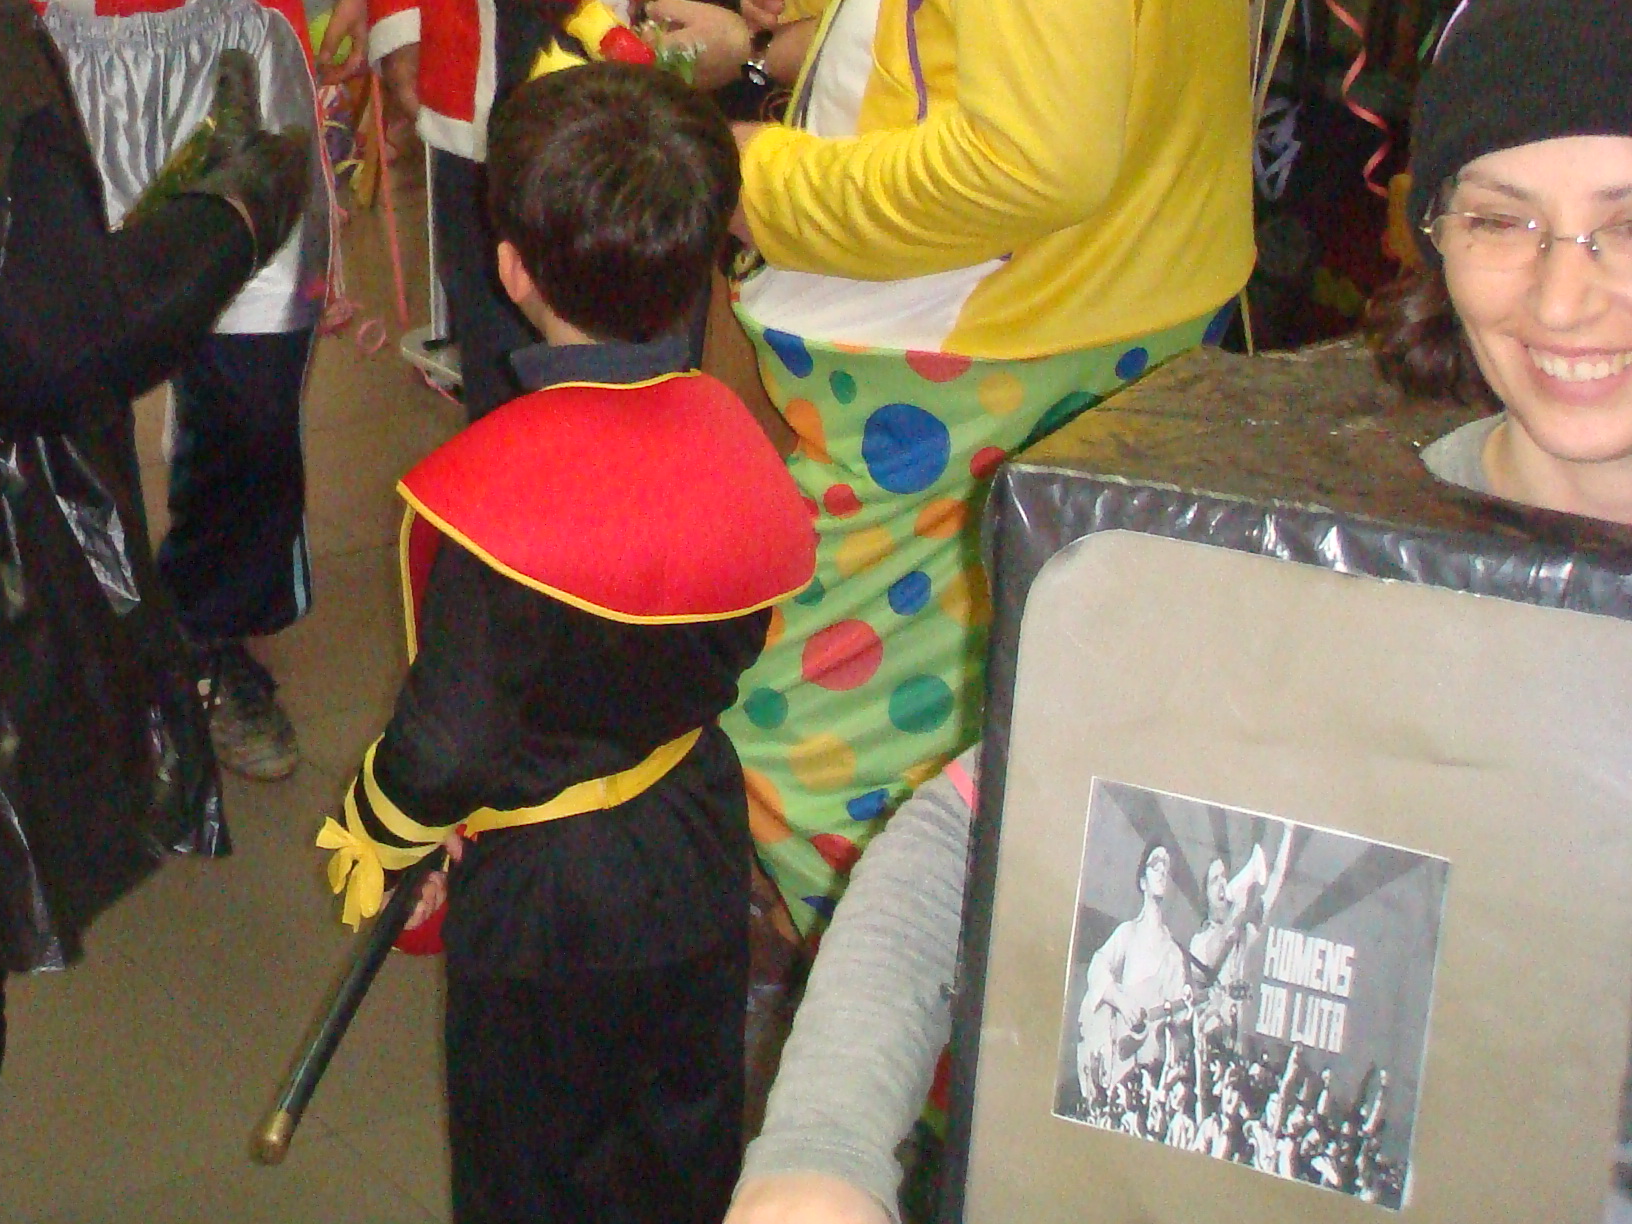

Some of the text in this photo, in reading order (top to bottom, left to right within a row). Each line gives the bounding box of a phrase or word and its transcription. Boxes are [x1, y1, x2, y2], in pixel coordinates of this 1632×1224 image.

[1263, 925, 1356, 998] HOMENS
[1255, 982, 1347, 1054] DA LUTA
